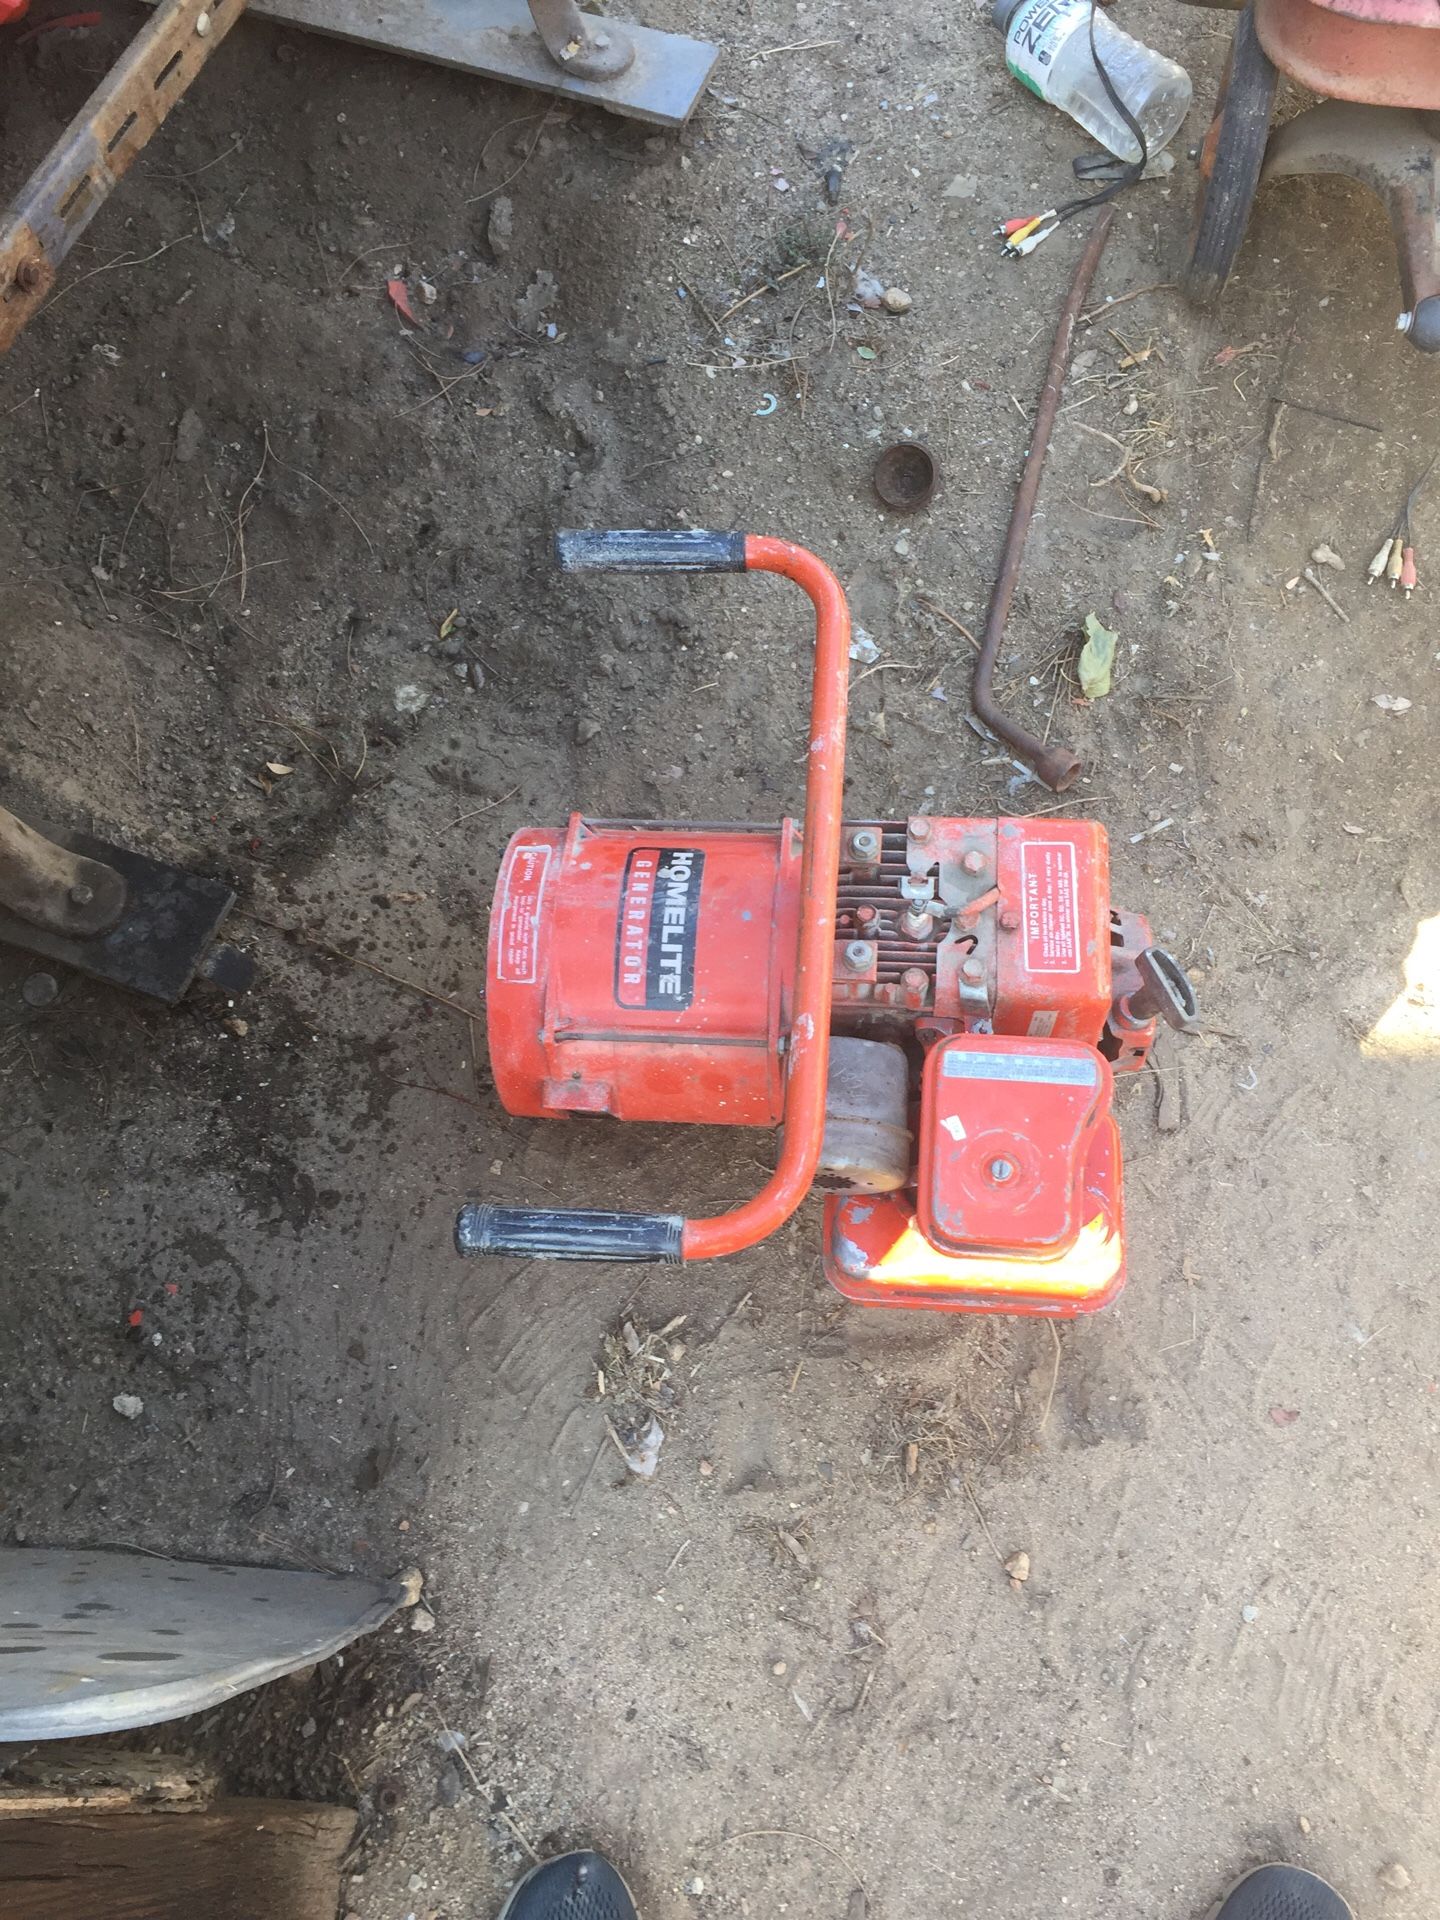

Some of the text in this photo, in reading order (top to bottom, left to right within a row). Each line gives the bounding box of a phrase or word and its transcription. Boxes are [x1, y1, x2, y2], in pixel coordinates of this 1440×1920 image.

[1013, 0, 1051, 44] POWE
[523, 852, 538, 881] CAUTION
[623, 860, 653, 984] GENERATOR
[658, 851, 695, 996] HOMELITE
[1028, 872, 1040, 940] IMPORTANT
